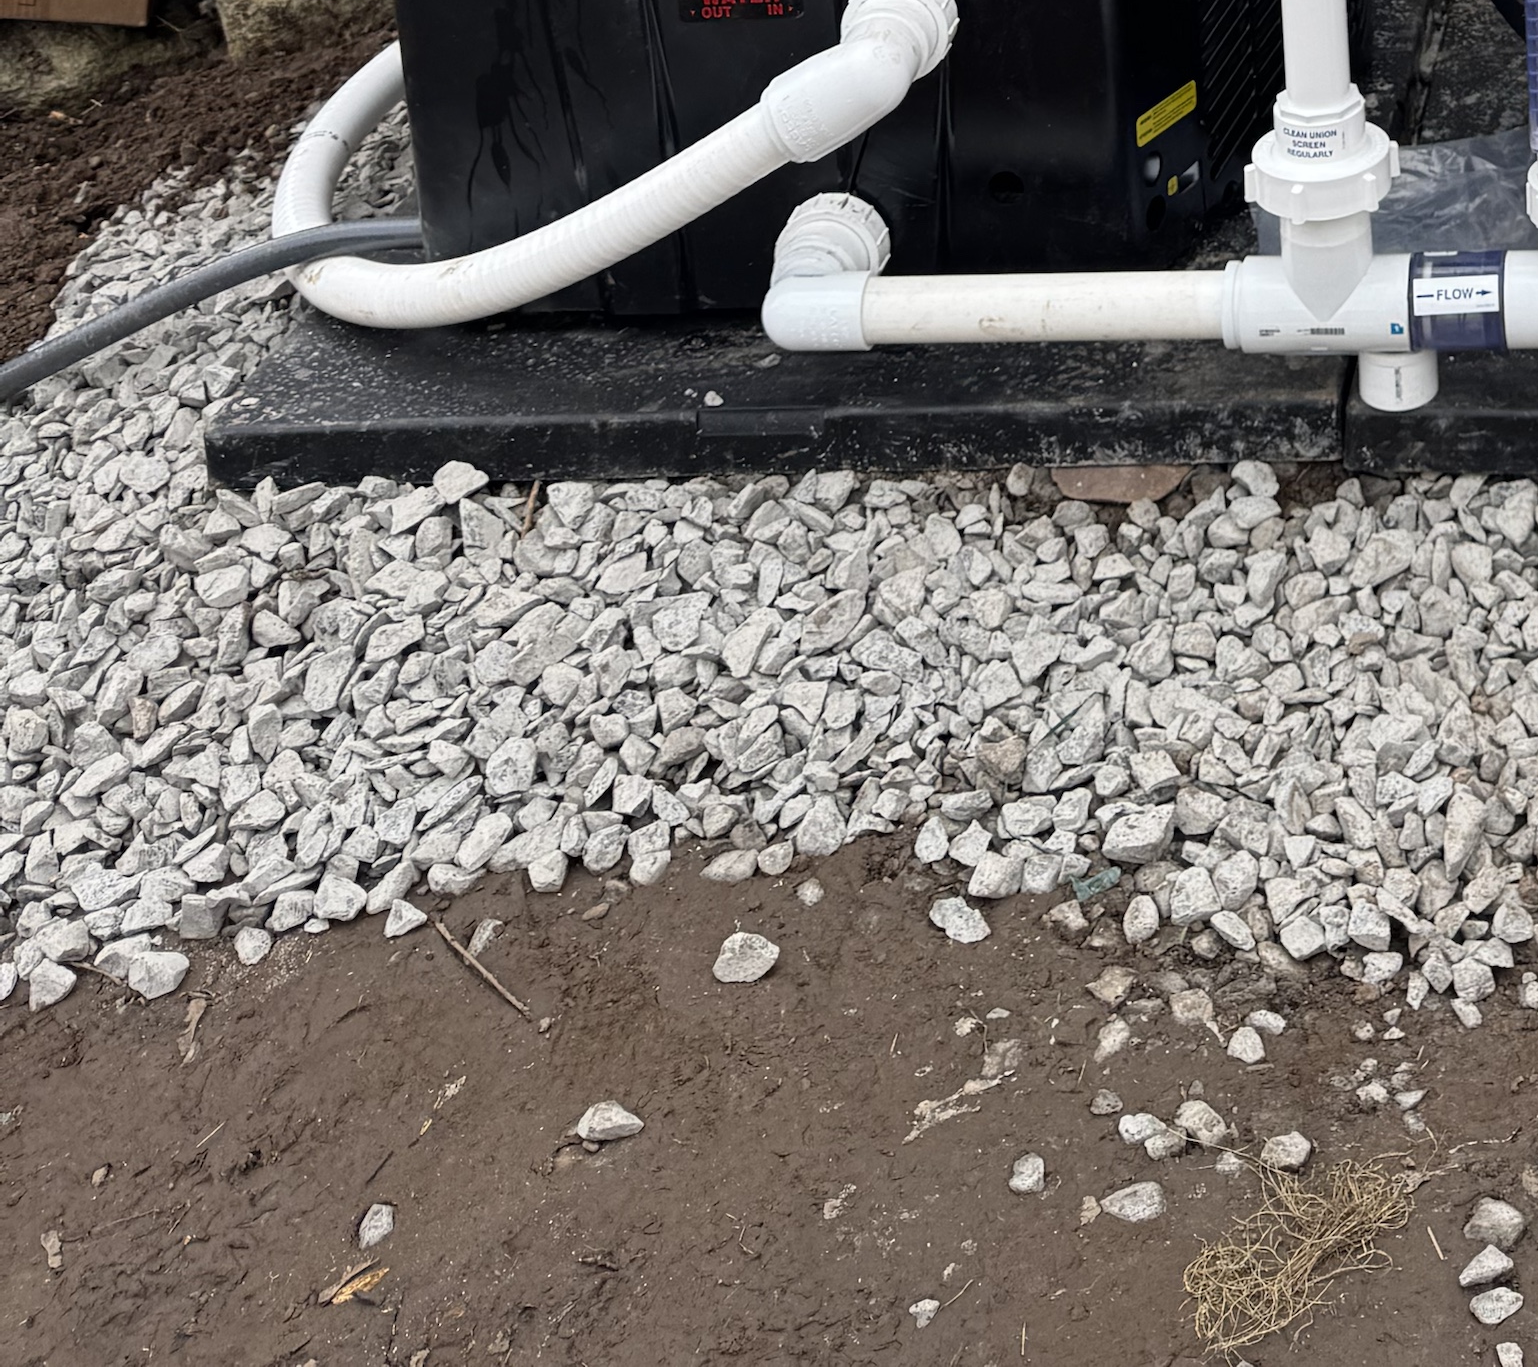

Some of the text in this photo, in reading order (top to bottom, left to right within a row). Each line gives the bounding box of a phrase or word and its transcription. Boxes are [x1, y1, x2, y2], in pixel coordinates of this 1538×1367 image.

[701, 4, 783, 19] OUT IN
[1283, 127, 1337, 139] CLEAN UNION
[1292, 140, 1326, 149] SCREEN
[1287, 148, 1334, 158] REGULARLY
[1436, 287, 1474, 301] FLOW
